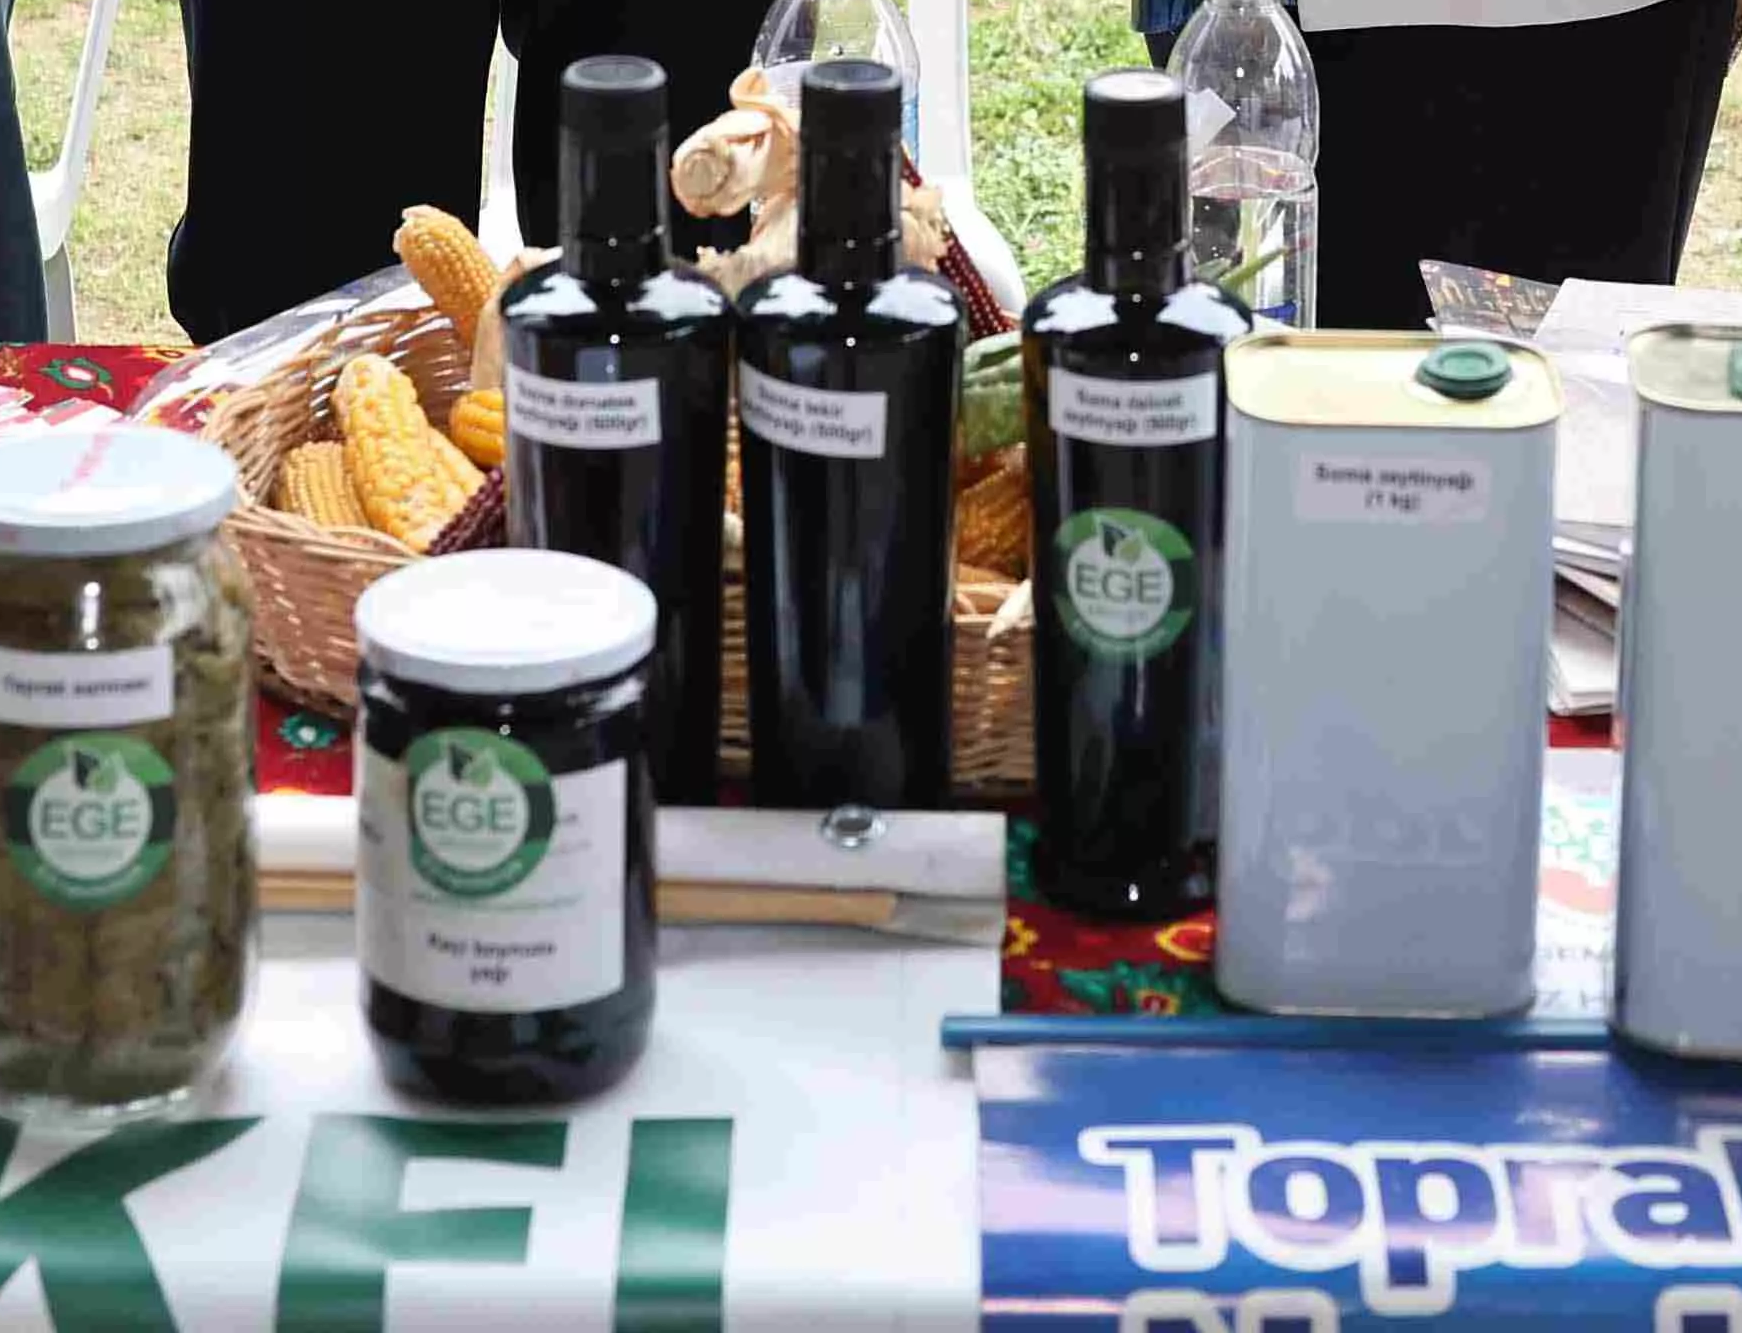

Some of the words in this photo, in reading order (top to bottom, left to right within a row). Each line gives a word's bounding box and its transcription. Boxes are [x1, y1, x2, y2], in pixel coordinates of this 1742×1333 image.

[1073, 564, 1165, 605] EGE
[40, 797, 143, 841] EGE
[421, 789, 519, 834] EGE
